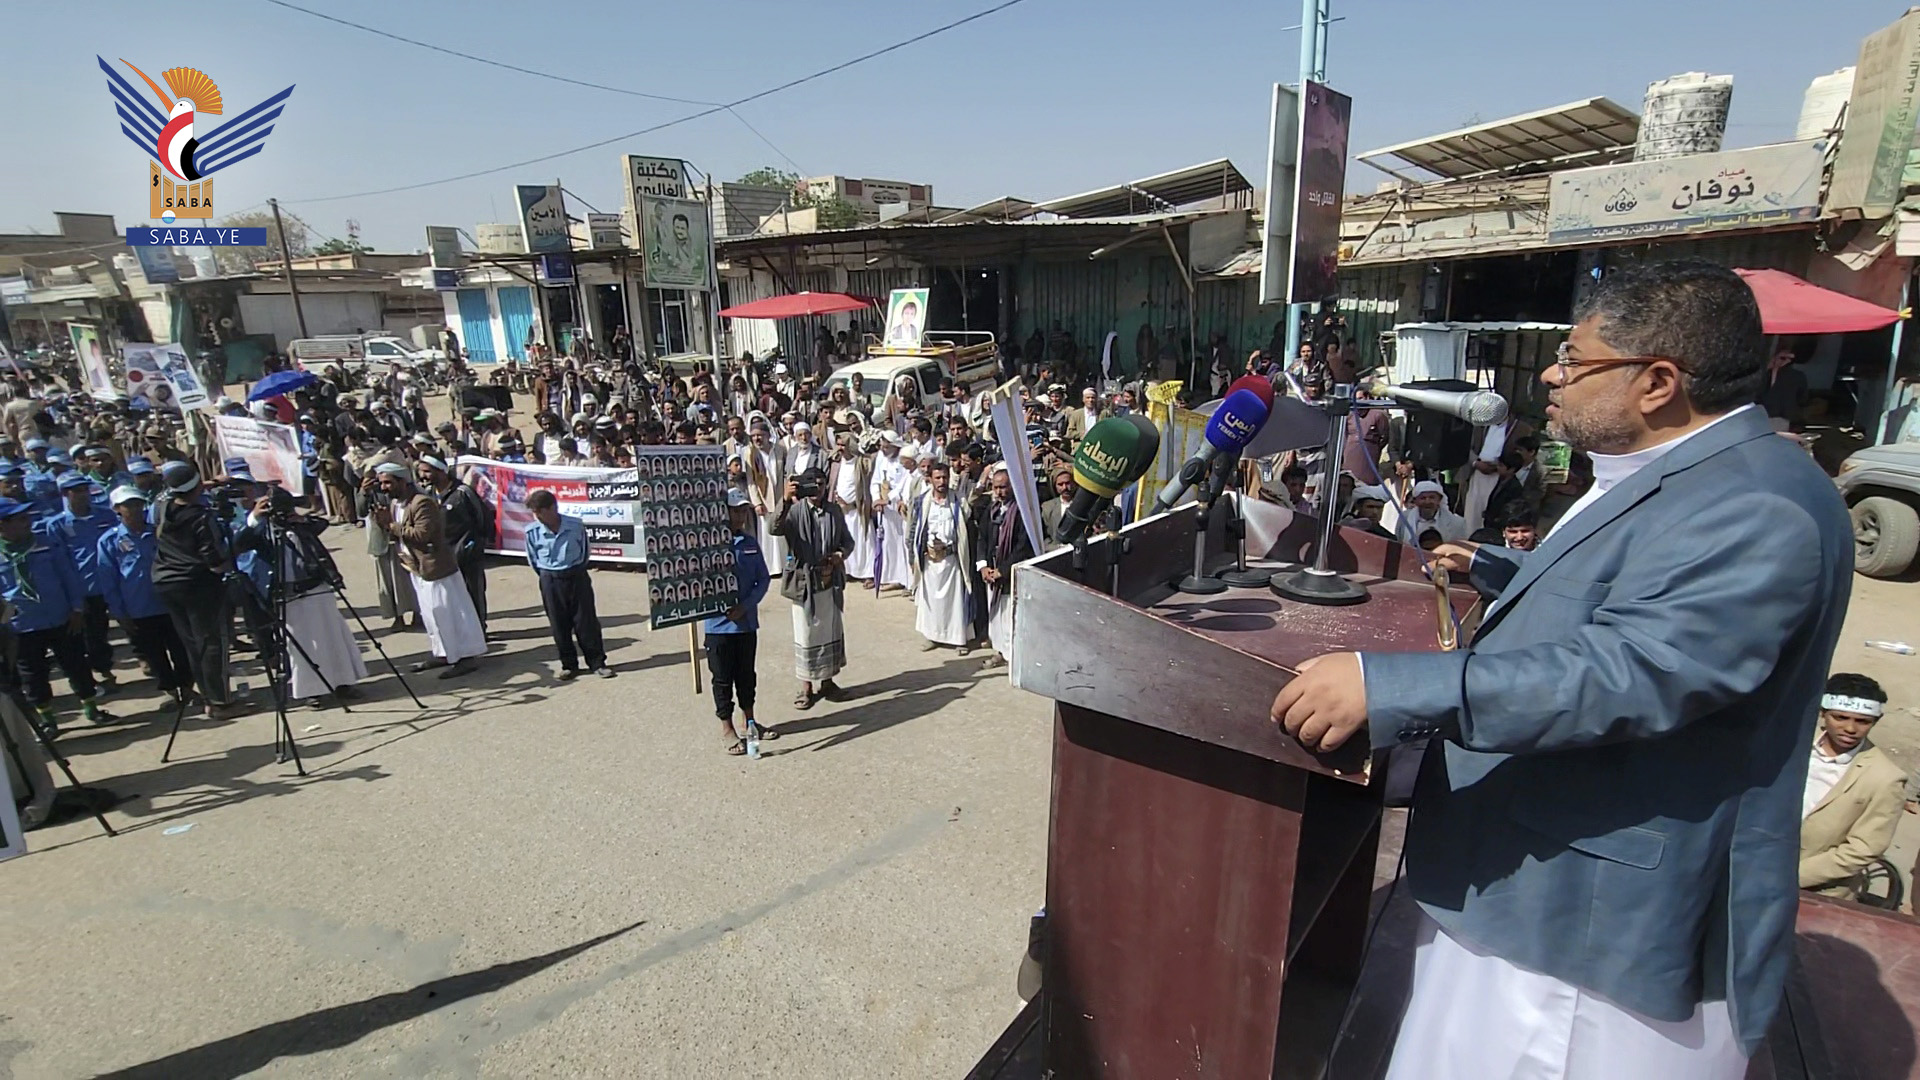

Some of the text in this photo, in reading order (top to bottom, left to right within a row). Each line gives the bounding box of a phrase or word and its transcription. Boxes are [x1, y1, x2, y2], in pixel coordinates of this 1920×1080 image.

[637, 162, 678, 181] مكتبة
[1718, 168, 1746, 179] مياه
[1672, 176, 1755, 210] نوفان
[531, 204, 560, 221] الأمين
[1217, 422, 1238, 441] YEMEN
[1224, 411, 1256, 437] اليمن
[611, 484, 639, 497] ويستمر
[572, 506, 602, 517] الطفولة
